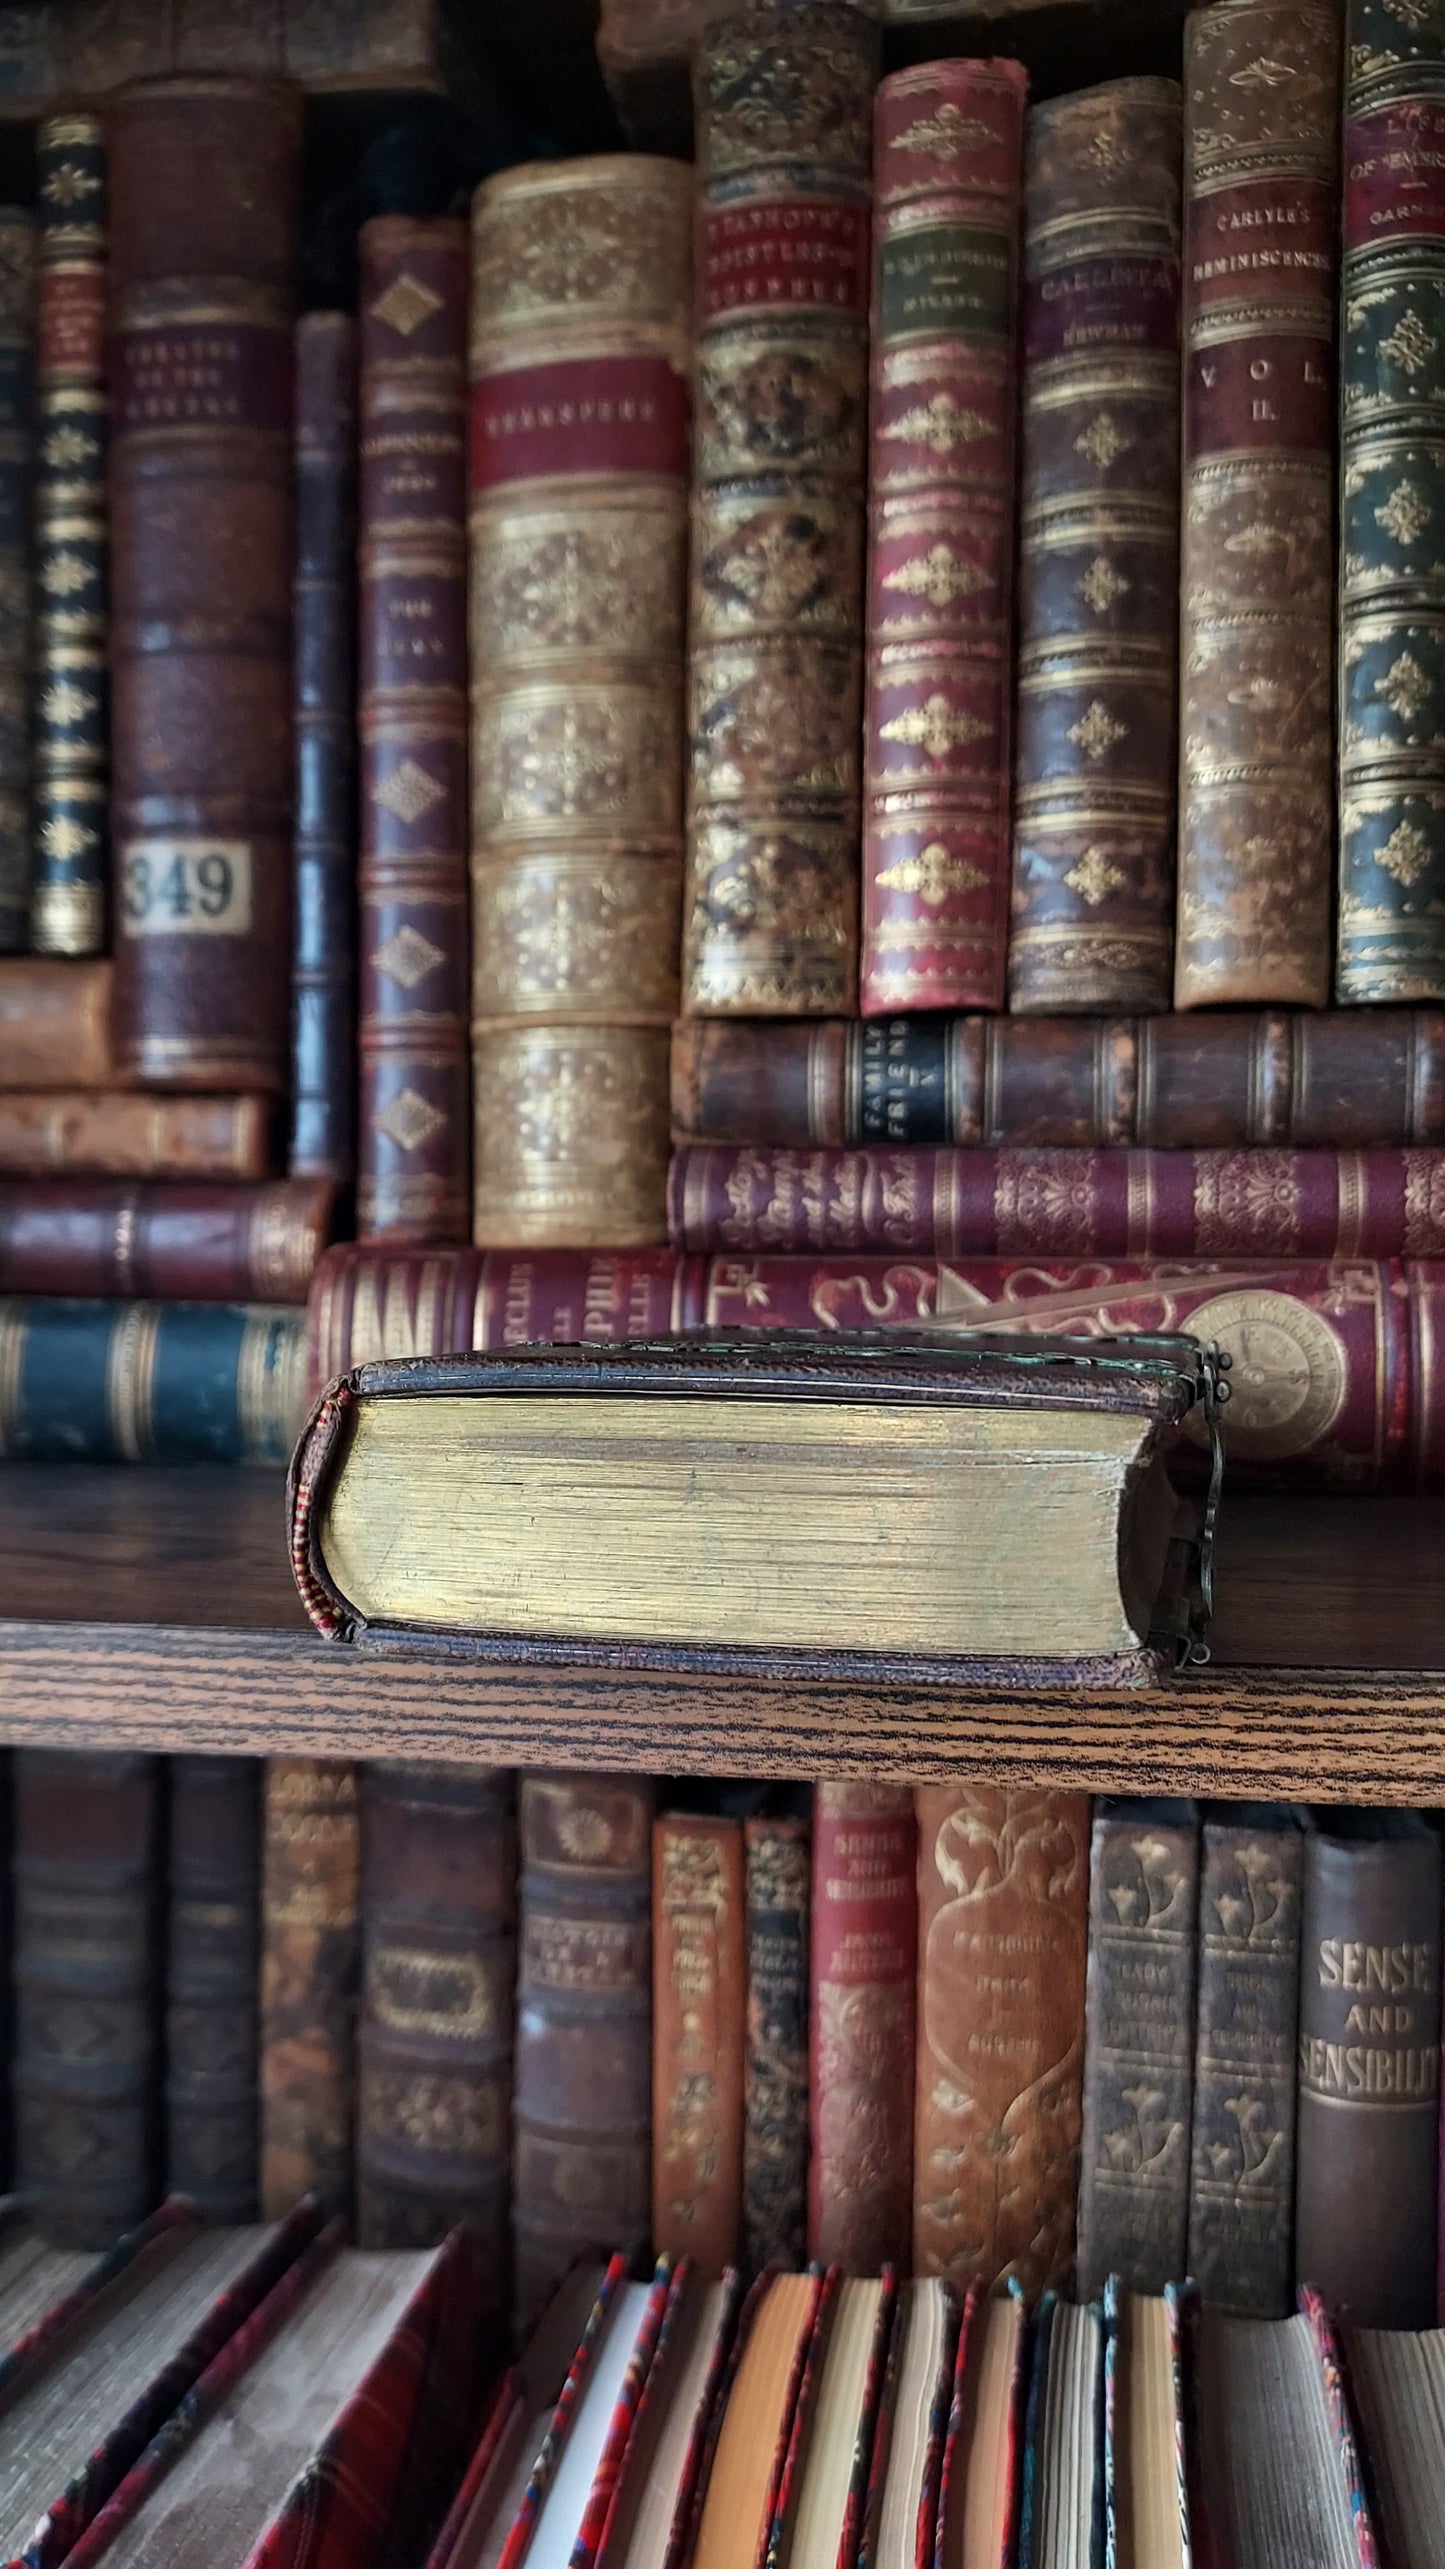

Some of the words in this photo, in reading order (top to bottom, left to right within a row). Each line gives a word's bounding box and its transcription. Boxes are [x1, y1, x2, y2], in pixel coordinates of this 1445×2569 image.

[1217, 202, 1311, 231] CARLYLE'S
[127, 854, 234, 920] 349
[864, 1026, 883, 1128] FAMILY
[888, 1020, 909, 1137] FRIEND
[1319, 1937, 1430, 1994] SENSE
[1344, 2003, 1416, 2035] AND
